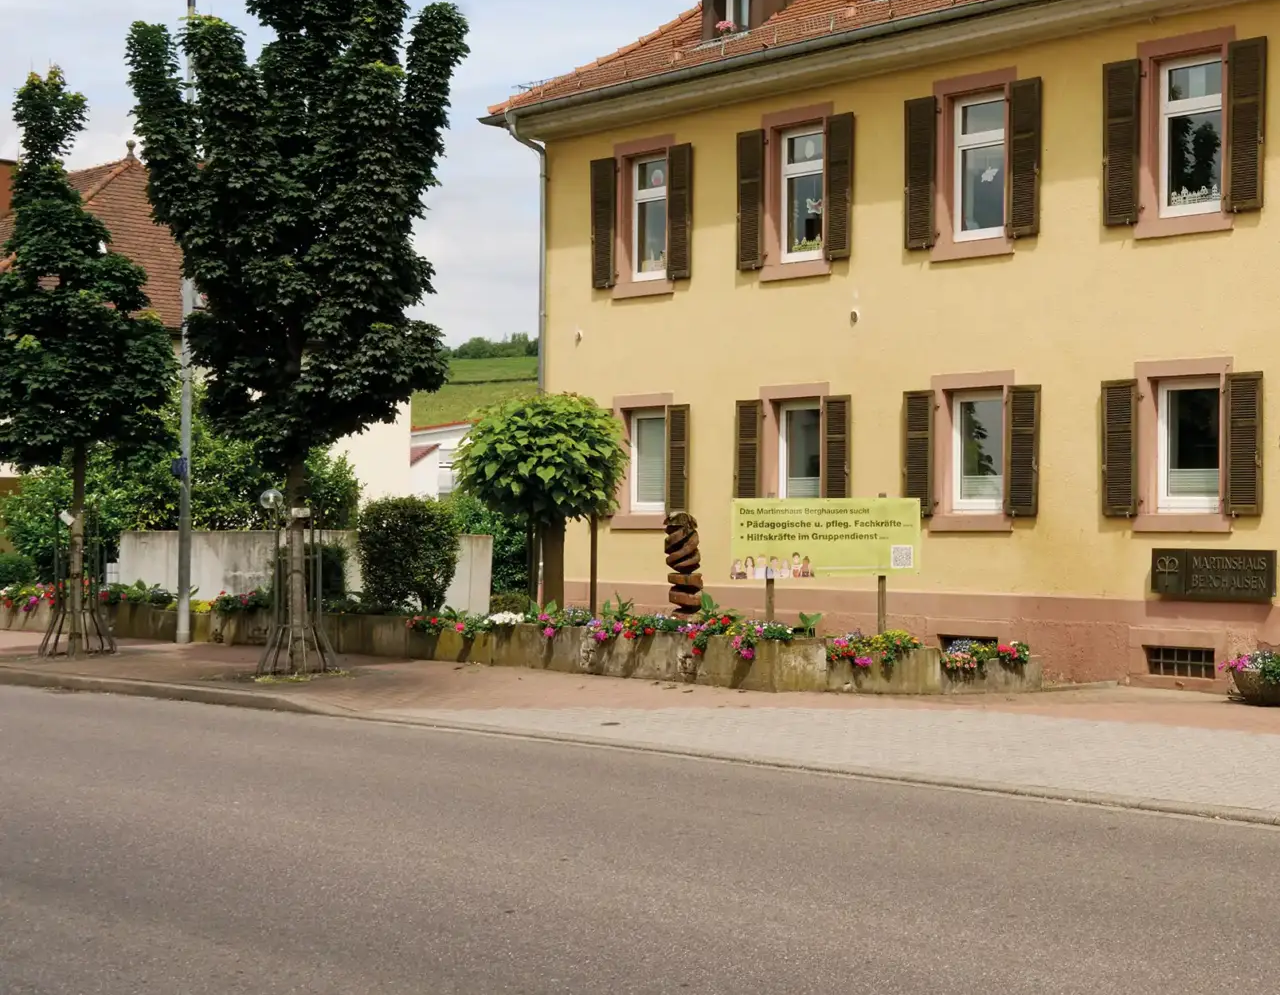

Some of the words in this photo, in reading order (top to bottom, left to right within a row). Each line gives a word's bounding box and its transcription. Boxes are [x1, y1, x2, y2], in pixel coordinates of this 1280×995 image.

[739, 507, 755, 515] Das
[756, 507, 803, 515] Martinshaus
[804, 507, 849, 516] Berghausen
[849, 507, 870, 515] sucht
[746, 519, 812, 530] Pädagogische
[826, 519, 852, 530] pfleg.
[854, 518, 902, 528] Fachkräfte
[746, 532, 797, 542] Hilfskräfte
[797, 532, 810, 541] im
[811, 532, 878, 542] Gruppendienst
[1192, 556, 1267, 571] MARTINSHAUS
